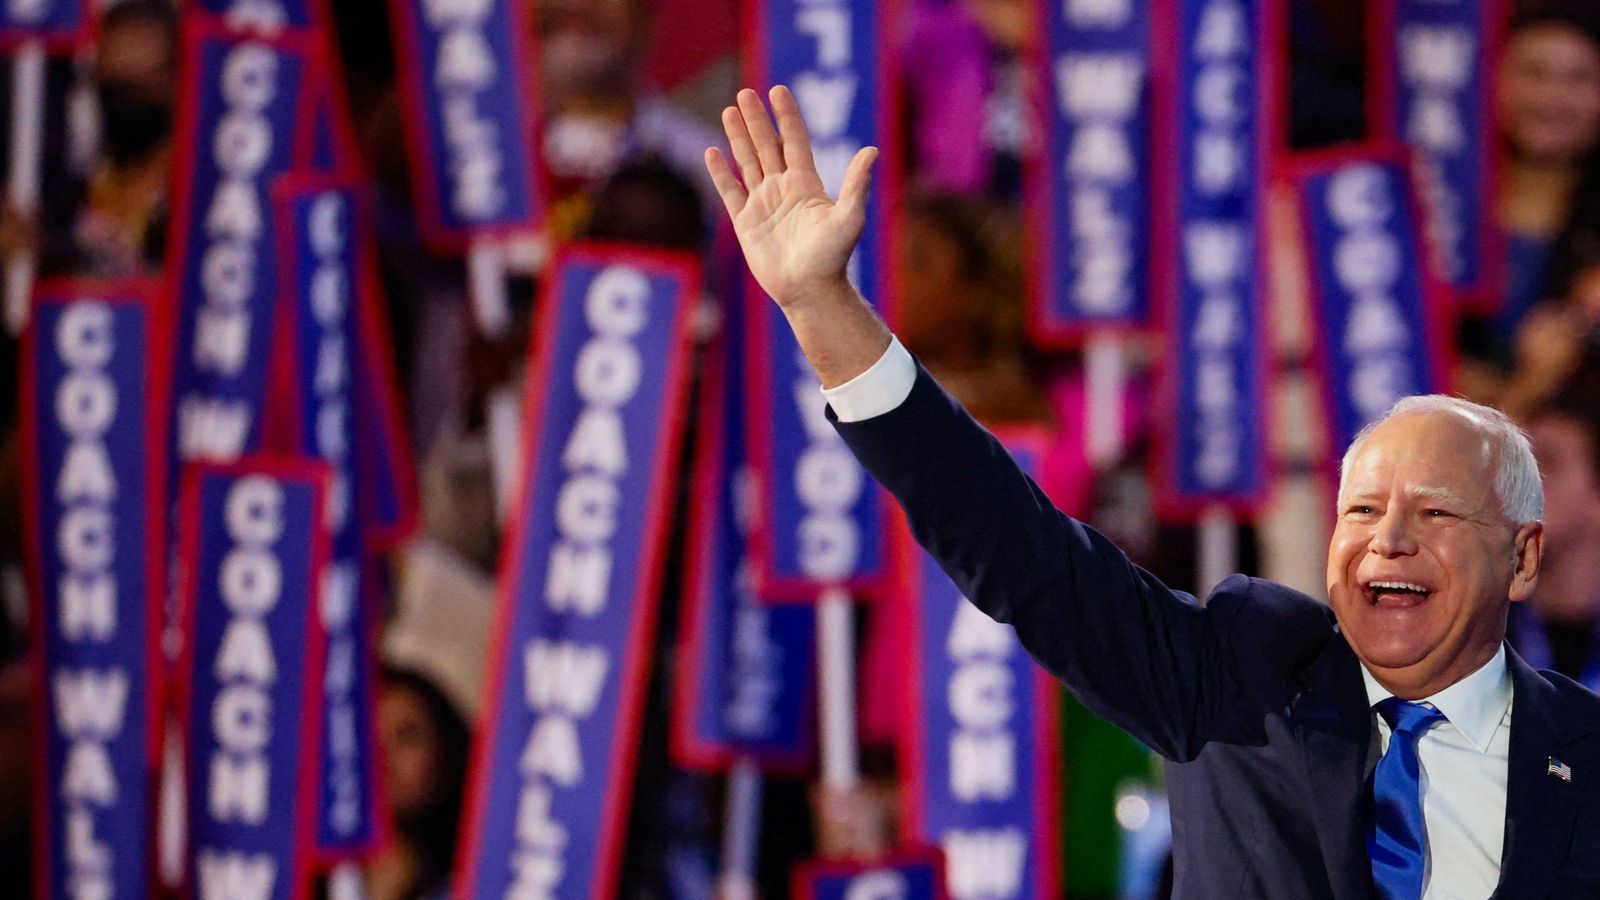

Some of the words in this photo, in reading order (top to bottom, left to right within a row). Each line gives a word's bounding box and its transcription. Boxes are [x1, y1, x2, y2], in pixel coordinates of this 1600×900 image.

[192, 44, 280, 376] COACH
[1056, 53, 1145, 314] WALZ
[1193, 0, 1246, 194] ACH
[544, 265, 652, 618] COACH
[1327, 162, 1412, 424] COAC
[57, 301, 119, 644] COACH
[208, 474, 288, 826] COACH
[947, 592, 1016, 803] ACH
